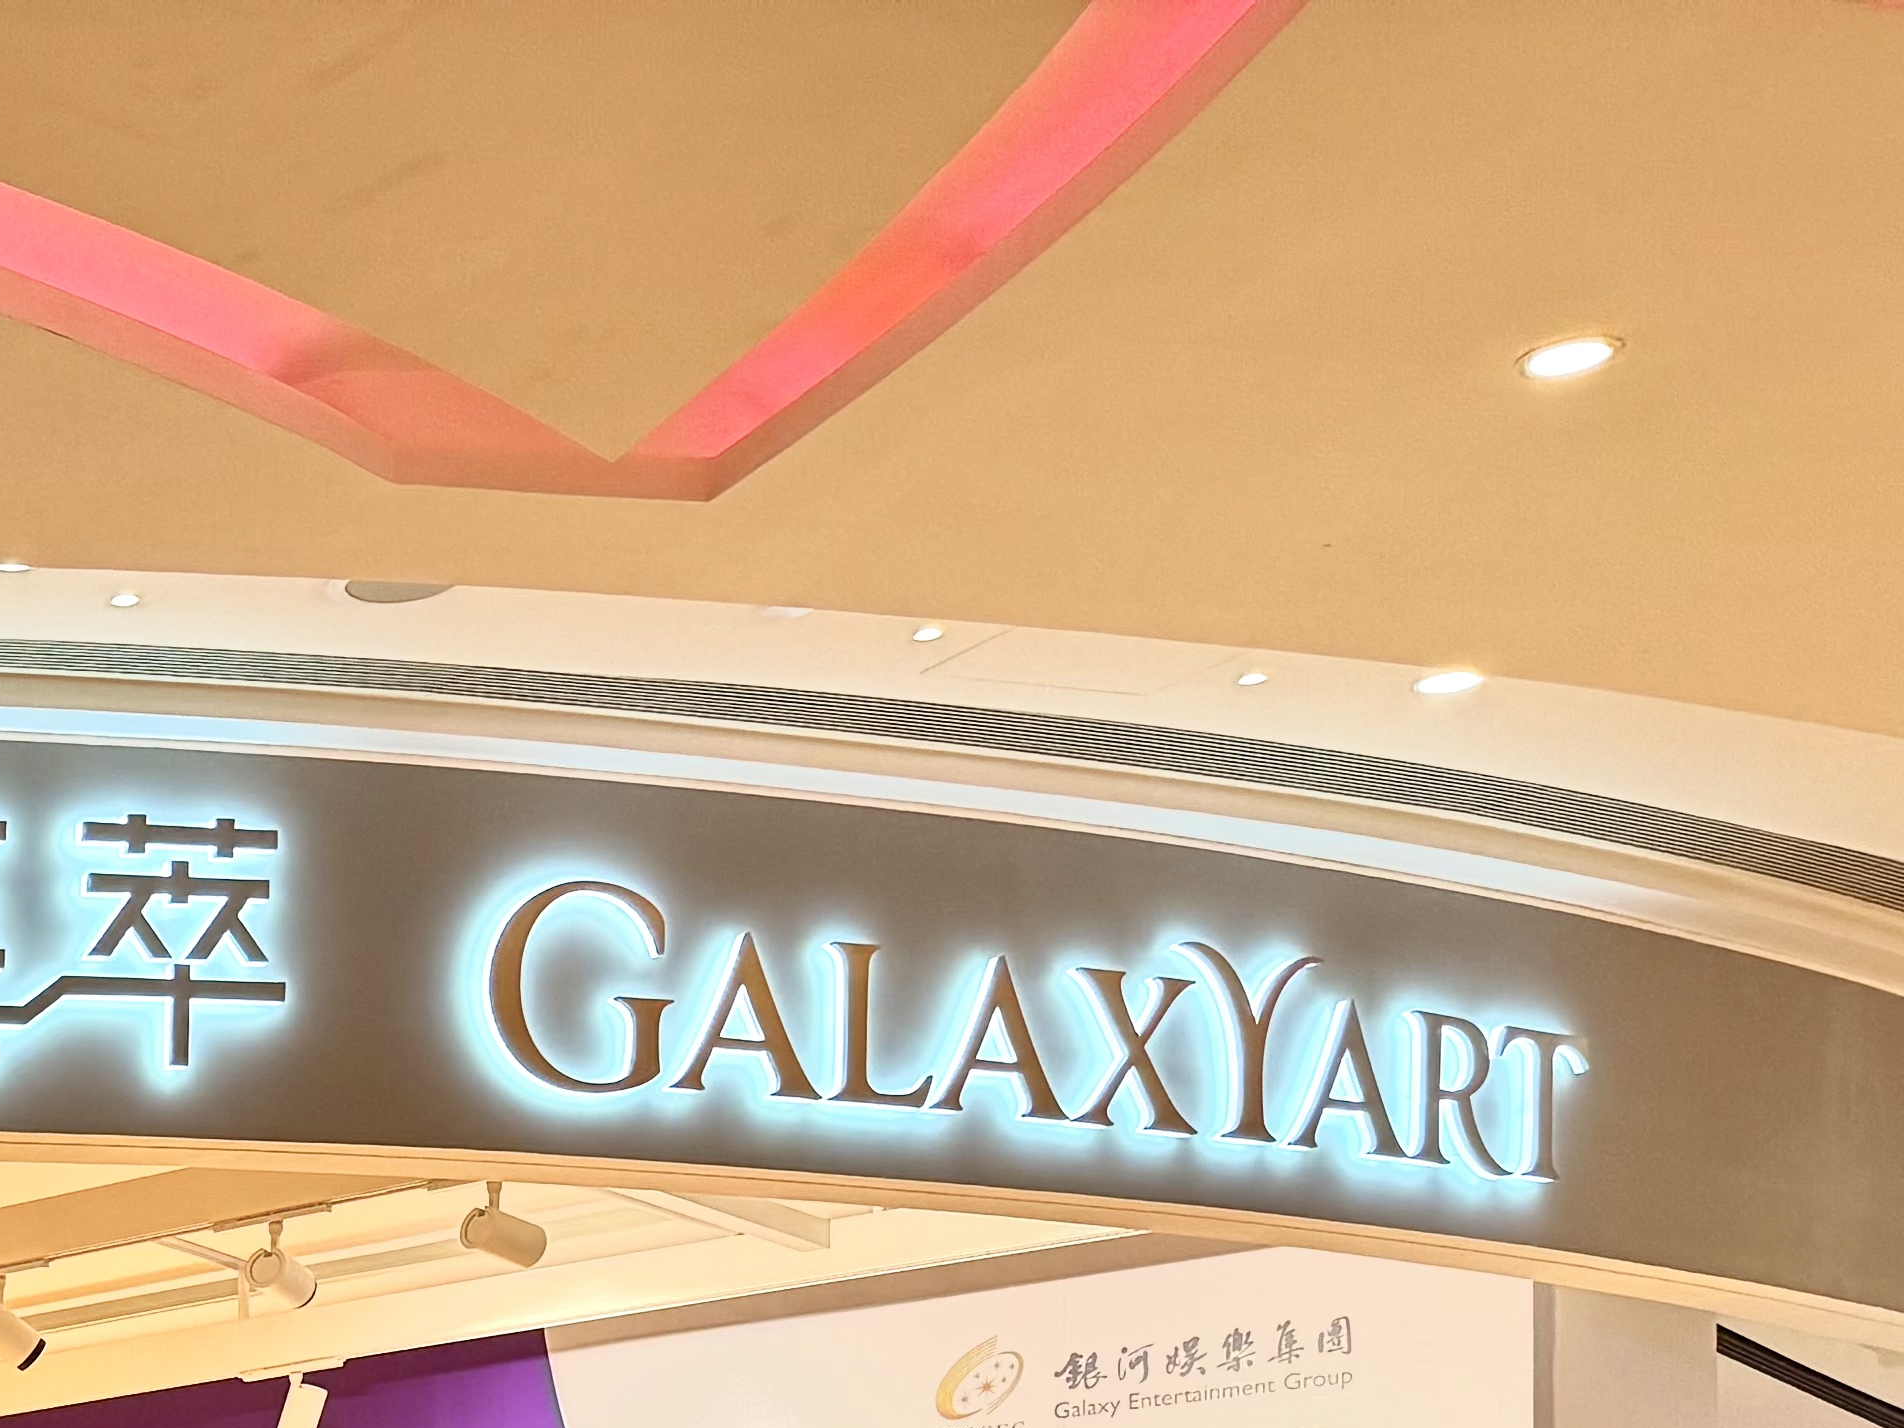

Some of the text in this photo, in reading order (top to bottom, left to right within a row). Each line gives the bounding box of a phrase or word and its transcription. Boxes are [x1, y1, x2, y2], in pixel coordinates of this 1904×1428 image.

[487, 879, 1588, 1183] GALAXYART
[1053, 1316, 1353, 1390] 銀河娛樂集團
[1054, 1369, 1353, 1420] Galaxy Entertainment Group
